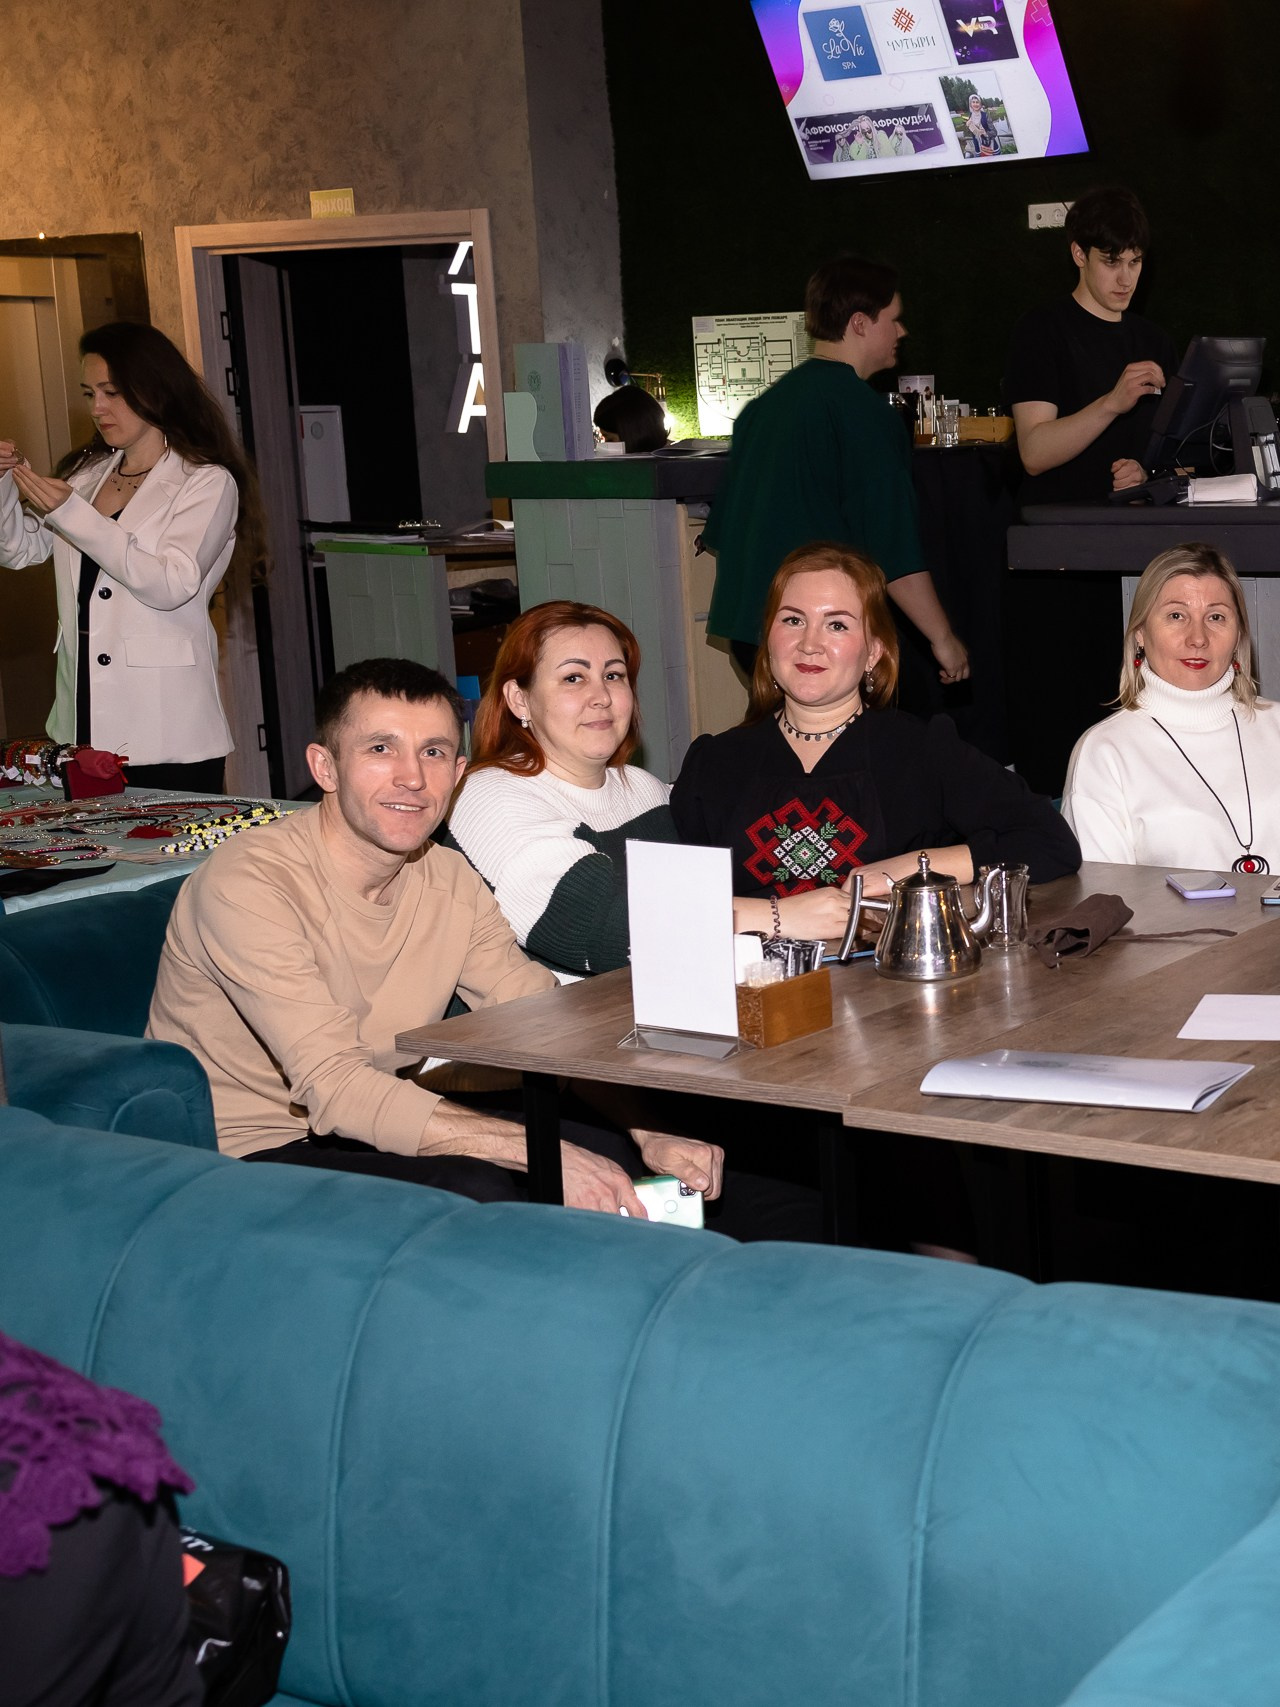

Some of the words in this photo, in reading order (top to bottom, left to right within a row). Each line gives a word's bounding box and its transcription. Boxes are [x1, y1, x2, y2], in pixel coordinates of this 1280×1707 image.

[956, 15, 999, 38] VR
[842, 61, 857, 70] SPA
[805, 121, 860, 136] АФРОКОС
[872, 114, 932, 129] АФРОКУДРИ
[313, 197, 353, 216] ВЫХОД
